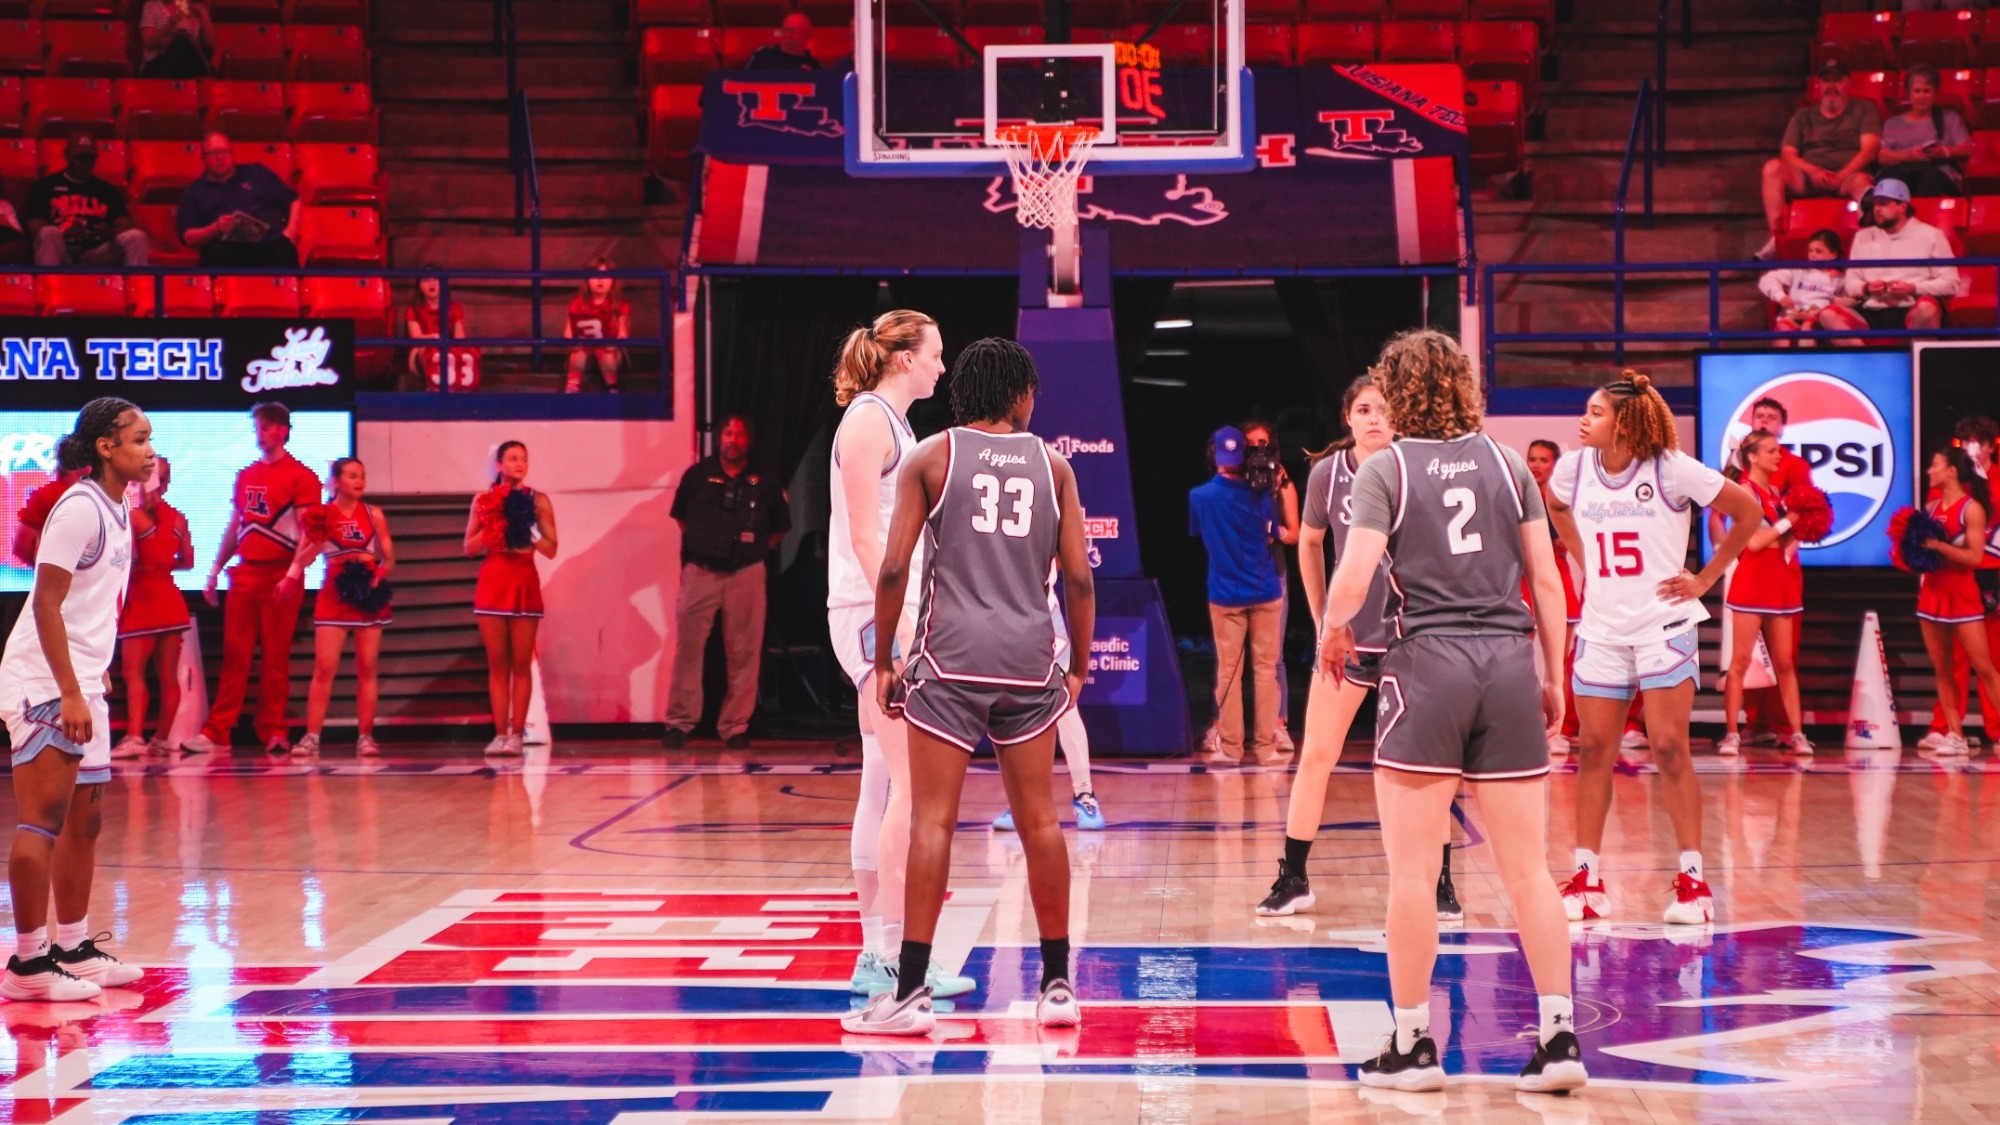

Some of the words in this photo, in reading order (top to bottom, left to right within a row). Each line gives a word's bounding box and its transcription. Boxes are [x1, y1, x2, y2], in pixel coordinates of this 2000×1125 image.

[873, 153, 910, 161] SPALDING
[0, 338, 79, 379] NA
[86, 339, 223, 379] TECH
[978, 448, 1027, 467] Aggies
[1427, 458, 1478, 480] Aggies
[1782, 442, 1883, 478] PSI
[971, 473, 1035, 538] 33
[1443, 487, 1483, 555] 2
[1596, 531, 1645, 578] 15
[1100, 655, 1140, 671] Clinic
